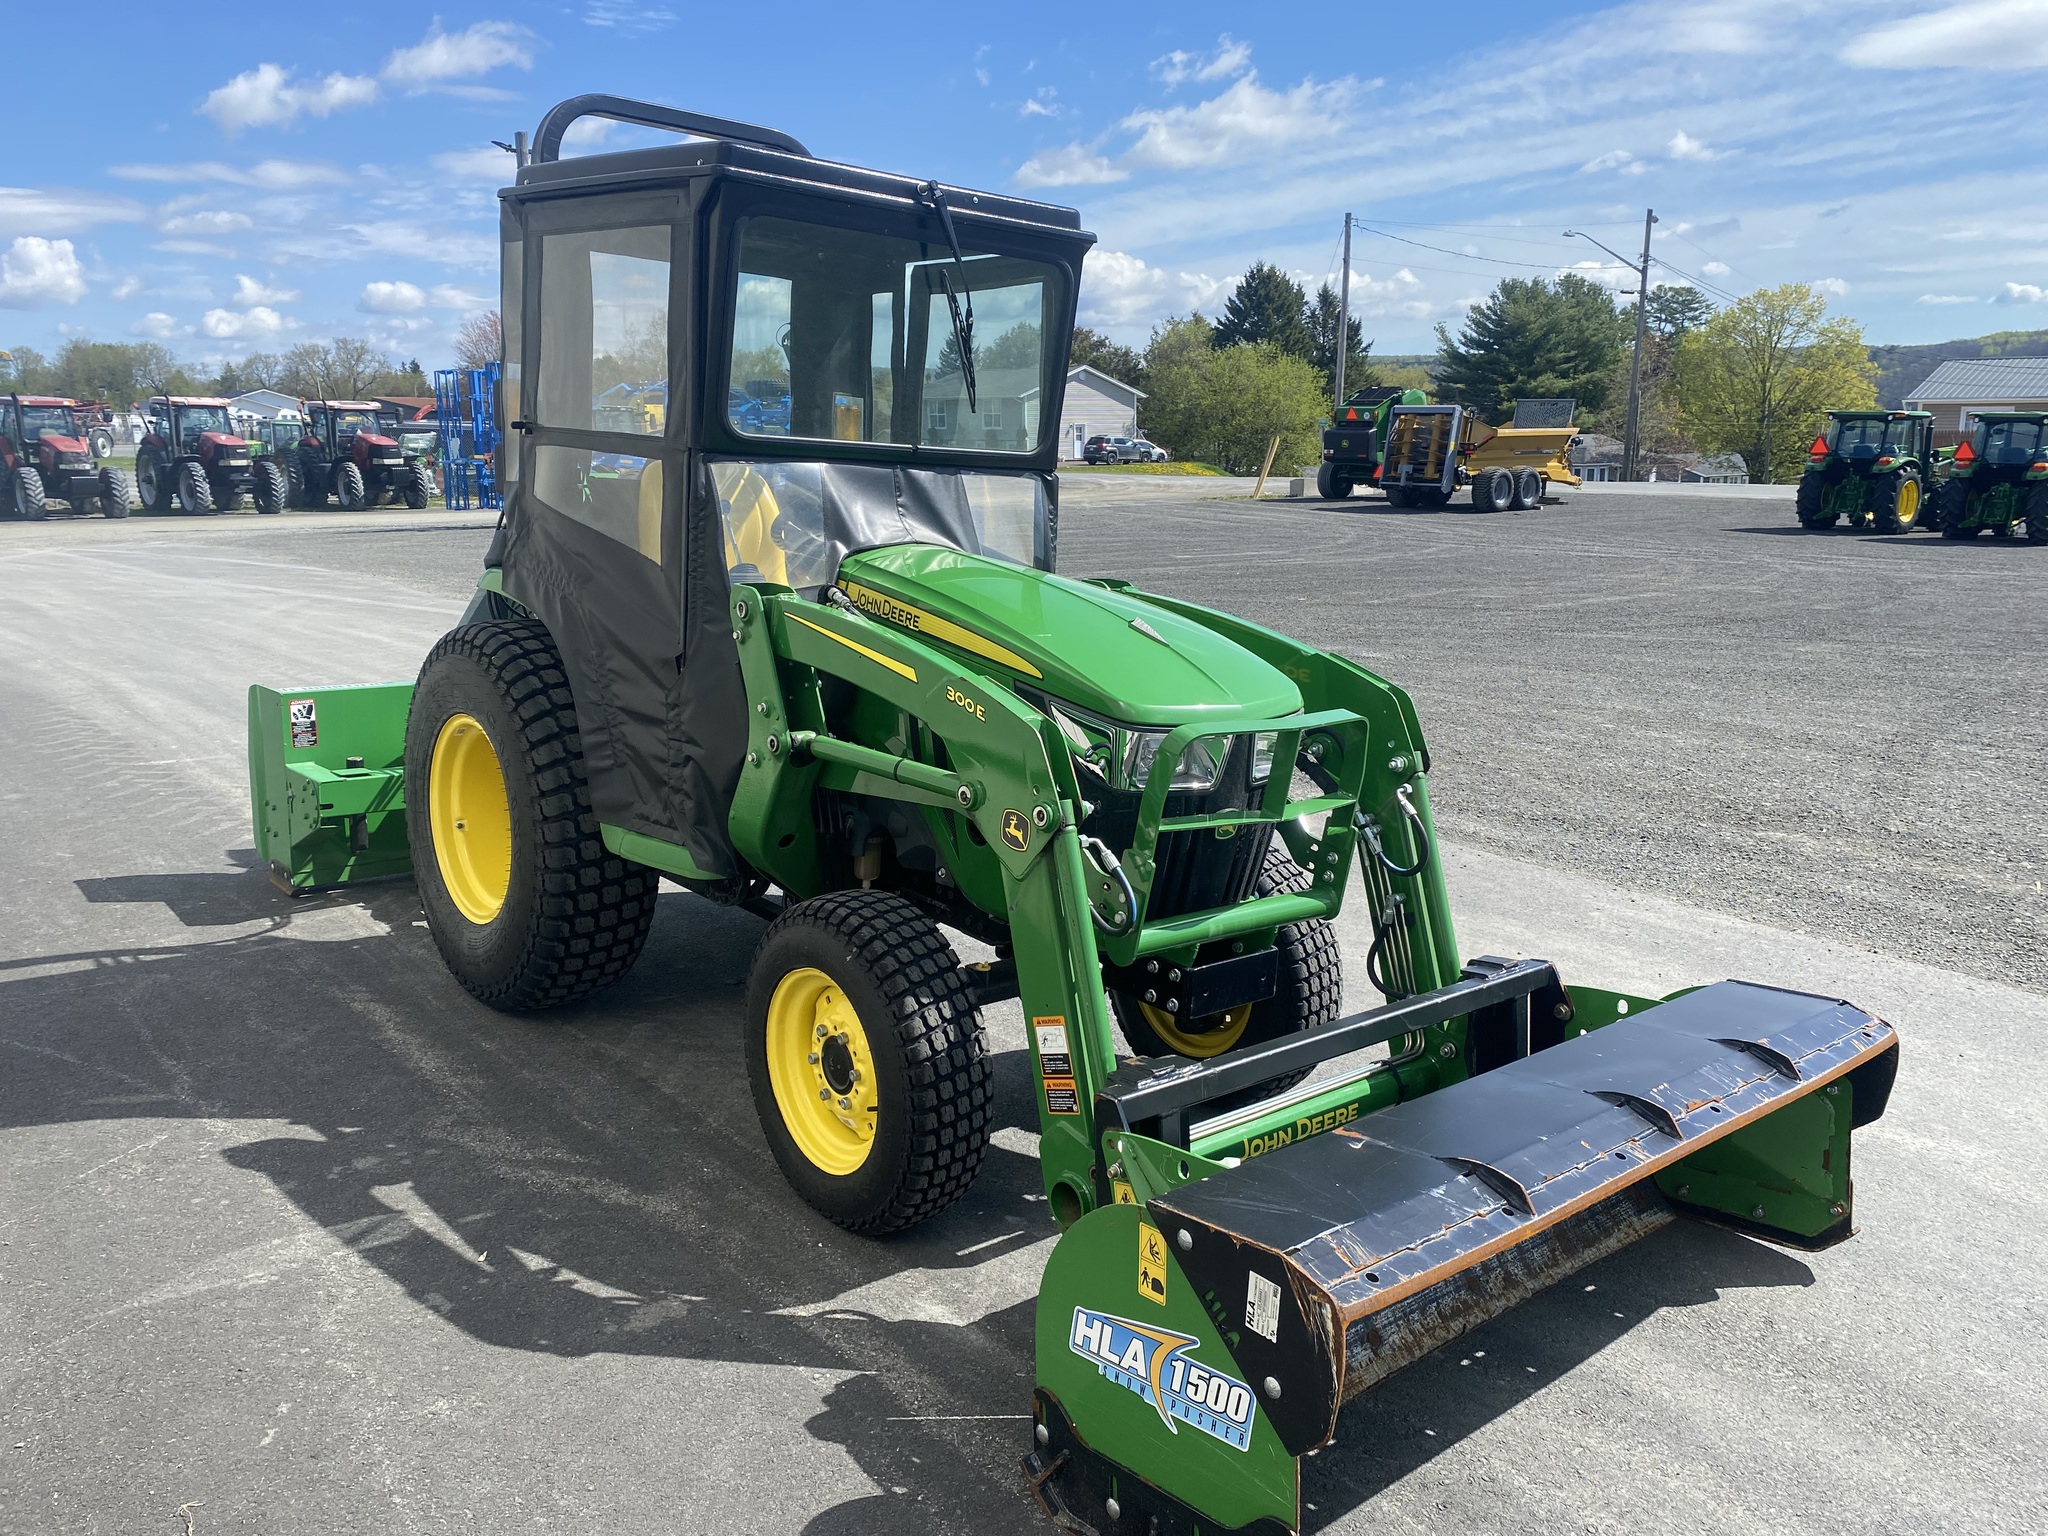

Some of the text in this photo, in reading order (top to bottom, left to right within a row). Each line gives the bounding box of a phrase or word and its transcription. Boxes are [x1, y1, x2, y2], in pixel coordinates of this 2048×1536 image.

[853, 589, 920, 629] JOHN DEERE
[1241, 1103, 1359, 1162] JOHN DEERE
[1246, 1300, 1256, 1328] HLA
[1074, 1312, 1251, 1424] HLA 1500
[1102, 1365, 1244, 1447] SNOW PUSHER
